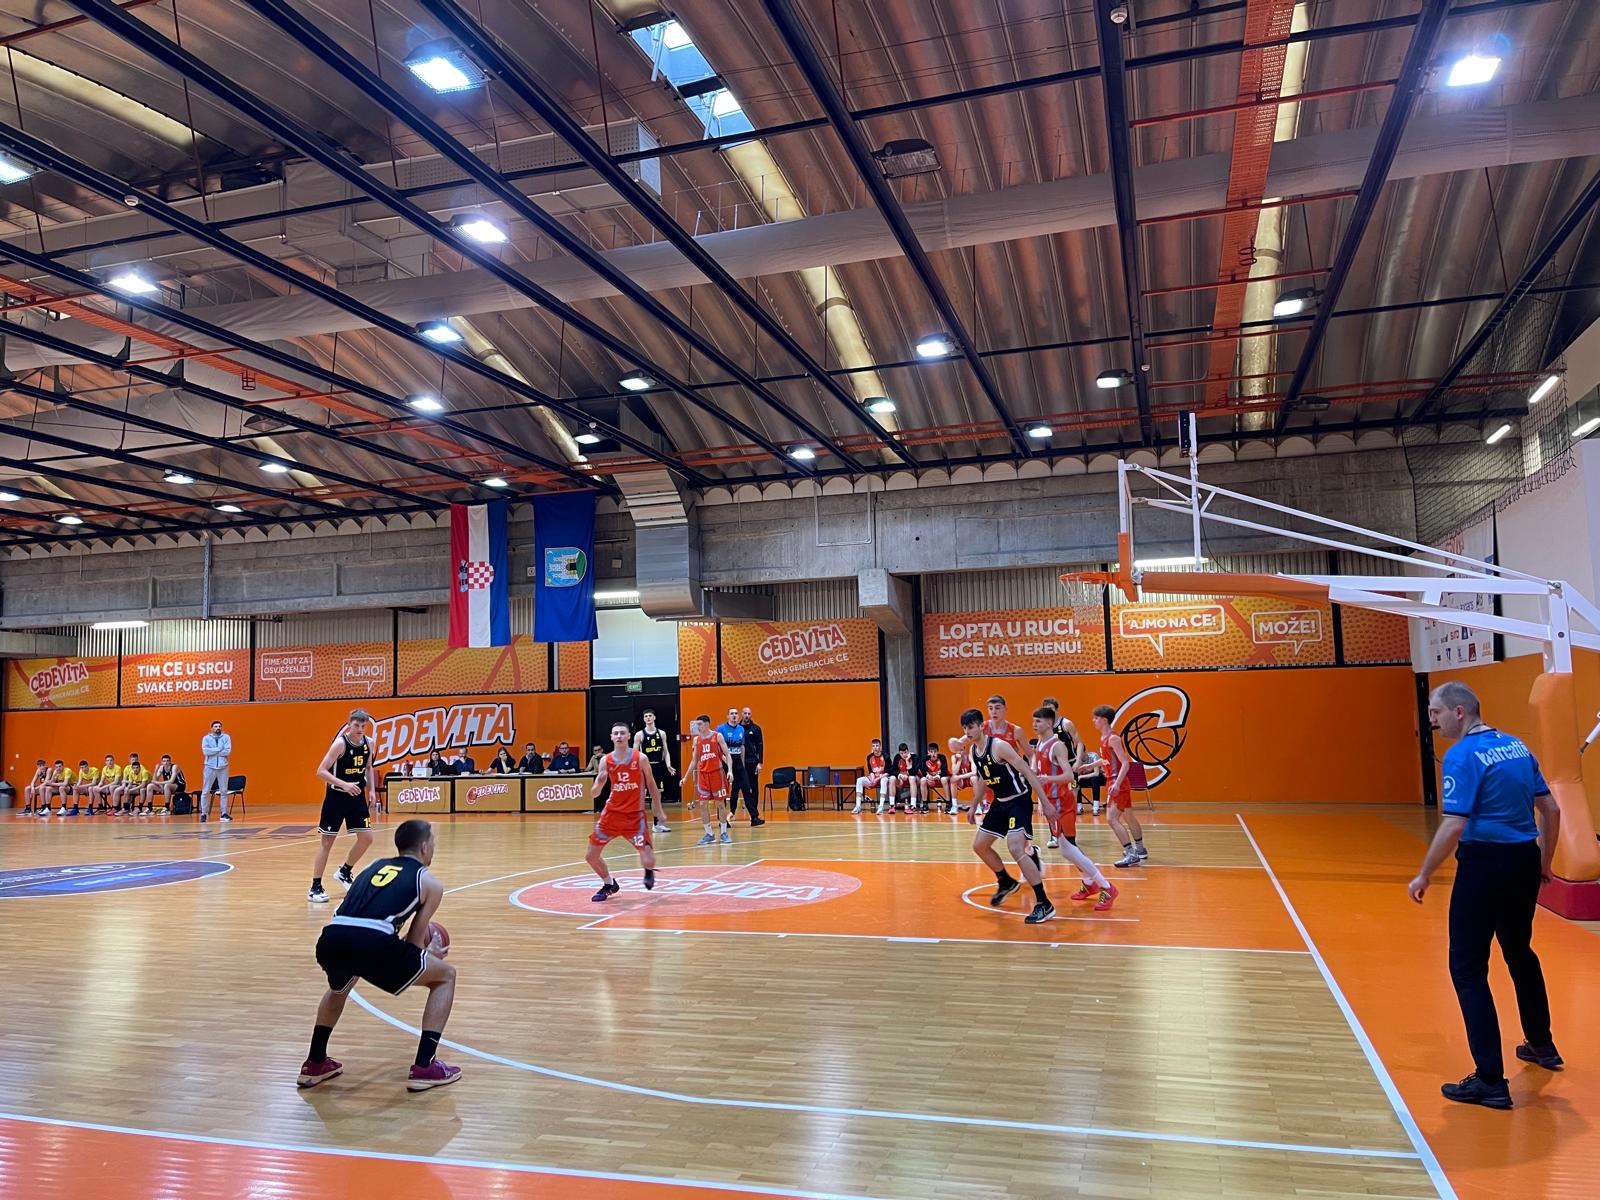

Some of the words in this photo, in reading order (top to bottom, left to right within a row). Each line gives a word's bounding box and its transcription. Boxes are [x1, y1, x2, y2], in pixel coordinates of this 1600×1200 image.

[939, 622, 1004, 640] LOPTA
[1007, 621, 1021, 637] U
[1024, 619, 1080, 638] RUCI,
[1169, 618, 1188, 628] NA
[1190, 614, 1217, 627] CE!
[1259, 617, 1316, 635] MOŽE!
[758, 624, 847, 664] CEDEVITA
[939, 641, 985, 659] SRCE
[988, 644, 1012, 657] NA
[1013, 640, 1082, 656] TERENU!
[137, 664, 161, 678] TIM
[163, 661, 184, 677] CE
[186, 662, 196, 676] U
[197, 661, 234, 675] SRCU
[767, 667, 789, 677] OKUS
[789, 657, 835, 672] GENERACIJE
[29, 661, 90, 693] CEDEVITA
[136, 681, 174, 694] SVAKE
[175, 678, 233, 692] POBJEDE!
[702, 743, 711, 753] 10
[353, 755, 364, 767] 15
[617, 771, 630, 782] 12
[983, 764, 991, 777] 8
[398, 786, 440, 804] CEDEVITA
[537, 783, 584, 802] CEDEVITA
[718, 788, 727, 798] 10
[1008, 817, 1016, 830] 8
[633, 834, 644, 847] 12
[371, 864, 403, 887] 5
